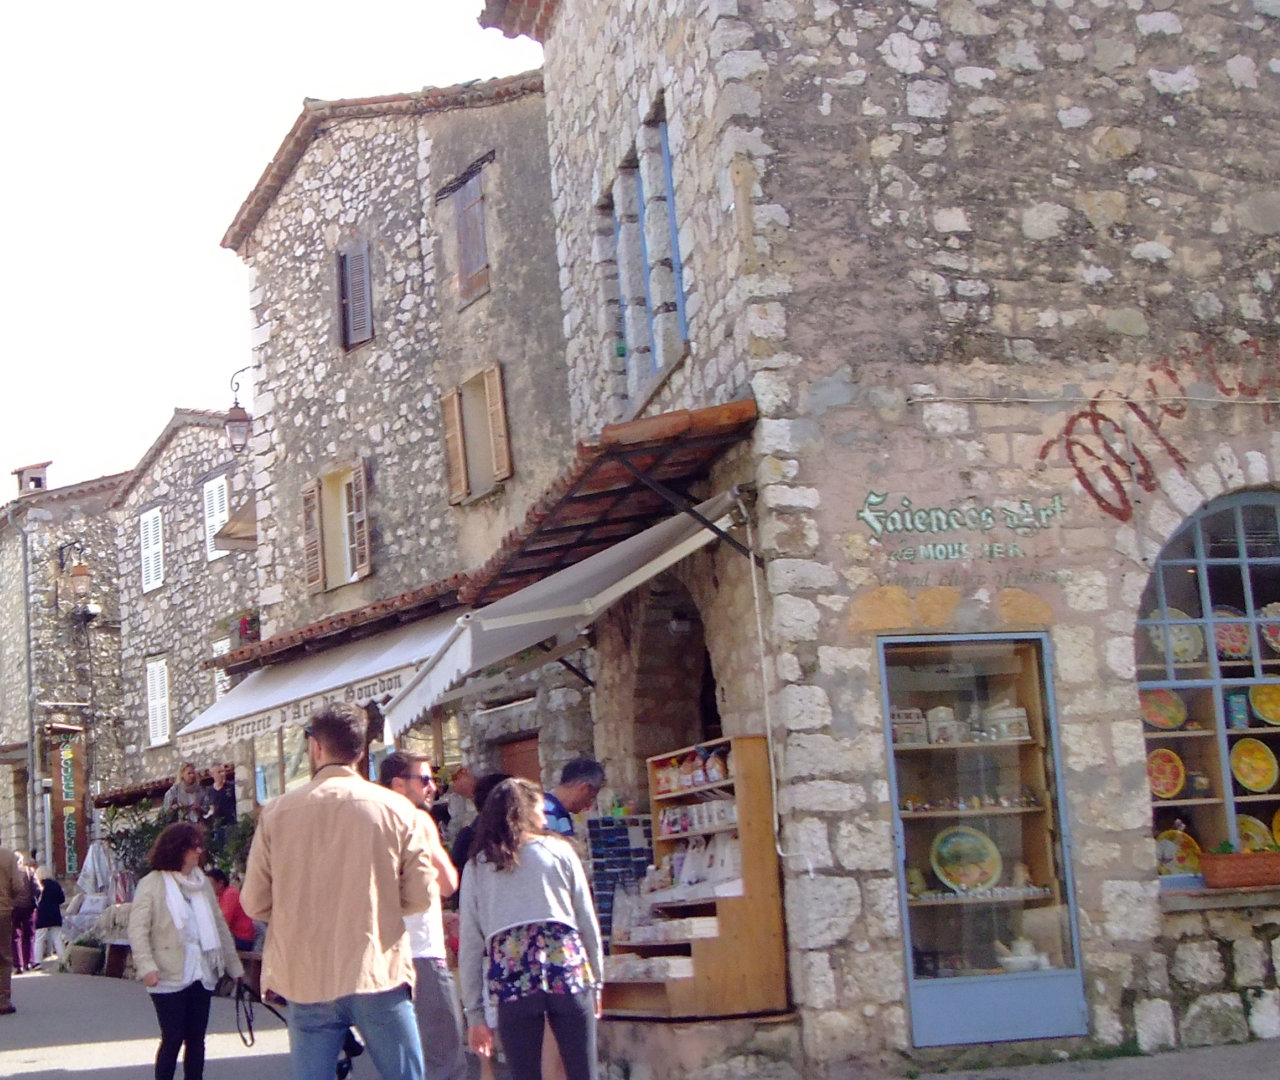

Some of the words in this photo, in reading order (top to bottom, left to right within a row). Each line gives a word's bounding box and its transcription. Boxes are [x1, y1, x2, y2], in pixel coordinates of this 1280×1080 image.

[226, 714, 272, 740] Verrerie
[344, 674, 402, 702] Gourdon
[60, 750, 75, 801] SOURCE
